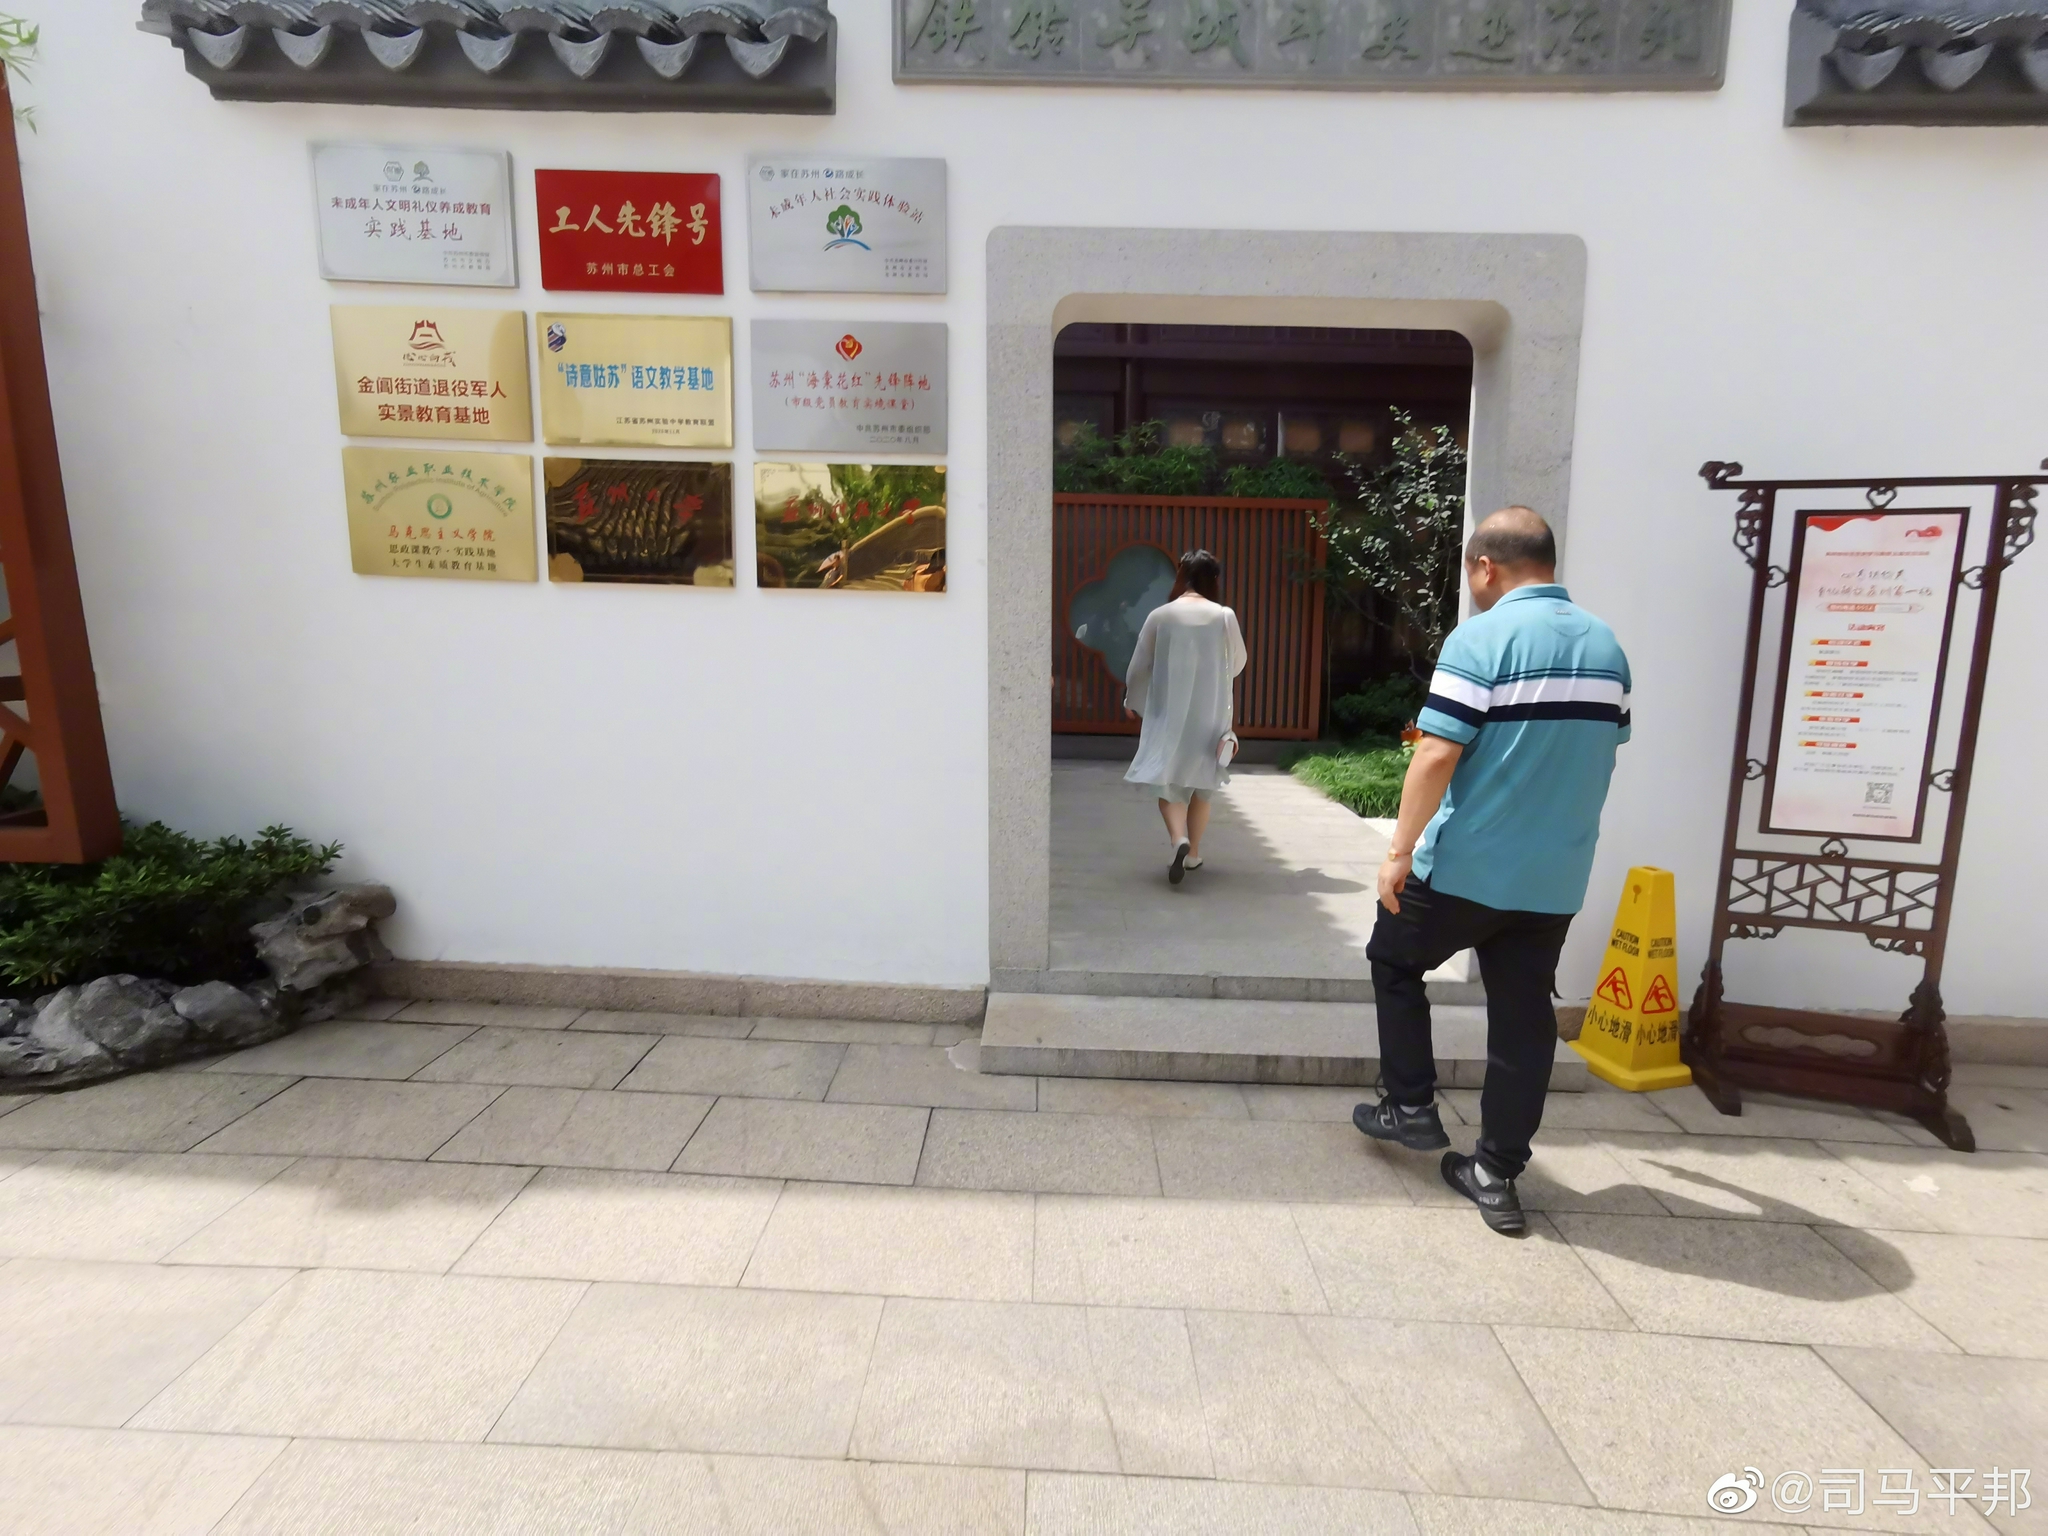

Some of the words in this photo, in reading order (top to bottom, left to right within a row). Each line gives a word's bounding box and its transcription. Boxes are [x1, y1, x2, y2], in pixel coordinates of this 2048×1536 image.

[331, 196, 491, 216] 未成年人文明礼仪养成教育
[769, 186, 925, 225] 未成年人社会实践体验站
[364, 216, 463, 241] 实践基地
[548, 200, 709, 247] 工人先锋号
[586, 261, 675, 277] 苏州市总工会
[357, 376, 507, 398] 金阊街道退役军人
[557, 362, 714, 391] “诗意姑苏”语文教学基地
[769, 370, 931, 391] 苏州“海棠花红”先锋阵地
[378, 404, 490, 424] 实景教育基地
[474, 488, 509, 517] Agriculture
[388, 525, 496, 541] 马克思主义学院
[391, 558, 497, 572] 大学生素质教育基地
[1616, 929, 1639, 946] CAUTION
[1651, 938, 1673, 947] CAUTION
[1612, 939, 1622, 950] WET
[1622, 943, 1639, 958] FLOOR
[1588, 1005, 1632, 1043] 小心地滑
[1636, 1019, 1679, 1046] 小心地滑
